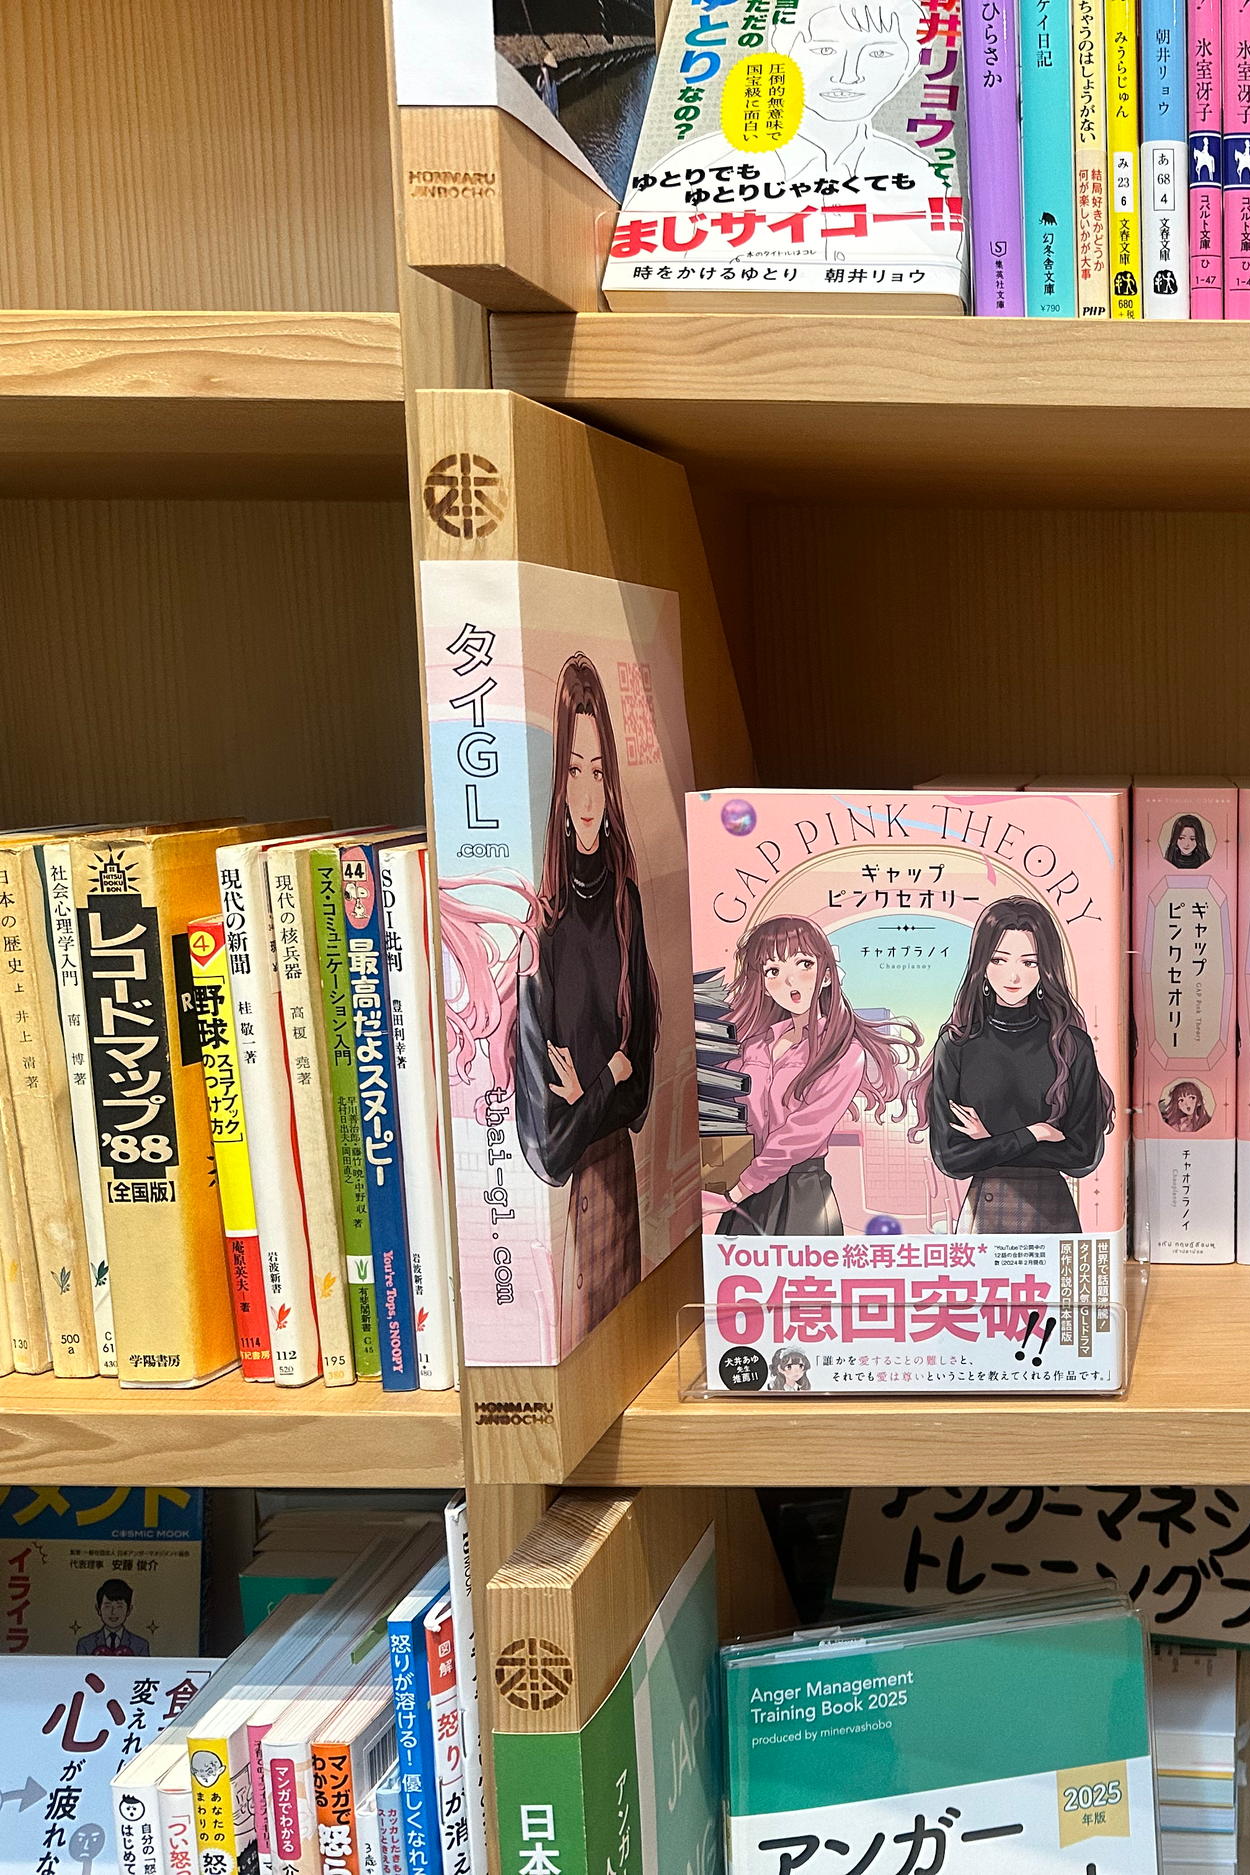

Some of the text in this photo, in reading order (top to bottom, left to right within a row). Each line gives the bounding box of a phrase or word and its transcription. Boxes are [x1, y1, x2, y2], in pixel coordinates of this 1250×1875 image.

[1114, 31, 1130, 118] みうらじゅん
[1155, 29, 1171, 116] 朝井リョウ
[1195, 37, 1213, 123] 氷室冴子
[743, 64, 763, 142] 国宝級に面白い
[766, 62, 786, 142] 圧倒的無意味で
[632, 163, 761, 191] ゆとりでも
[1158, 152, 1169, 166] あ
[684, 173, 916, 207] ゆとりじゃなくても
[1117, 177, 1130, 188] 23
[1157, 173, 1171, 185] 68
[1120, 195, 1127, 207] 6
[1160, 193, 1168, 205] 4
[609, 197, 965, 258] まじサイコー!!
[1078, 169, 1092, 280] 何が楽しいかが大事
[1091, 169, 1105, 272] 結局好きかどうか
[1159, 217, 1170, 262] 文春文庫
[1199, 194, 1211, 250] コバルト文庫
[1119, 218, 1131, 265] 文春文庫
[632, 265, 926, 284] 時をかけるゆとり 朝井リョウ
[1042, 232, 1056, 295] 幻冬舎文庫
[1195, 275, 1217, 285] 1-47
[994, 260, 1005, 310] 集英社文庫
[1118, 299, 1133, 309] 680
[1082, 306, 1106, 316] PHP
[446, 622, 510, 858] タイGL .com
[344, 863, 364, 880] 44
[712, 803, 1102, 926] GAP PINK THEORY
[861, 862, 946, 884] ギャップ
[828, 889, 980, 909] ピンクセオリー
[50, 865, 79, 987] 社会心理学入門
[220, 868, 251, 975] 現代の新聞
[275, 874, 303, 980] 現代の核兵器
[381, 869, 403, 973] SDI批判
[1191, 901, 1209, 977] ギャップ
[317, 866, 352, 1067] マス・コミュニケーション入門
[860, 945, 950, 959] チャオプラノイ
[879, 962, 932, 971] Chaoplanoy
[1167, 901, 1186, 1048] ピンクセオリー
[87, 911, 174, 1164] レコードマップ '88
[347, 938, 395, 1186] 最高だよスヌーピー
[484, 1086, 515, 1306] thai-gl.com
[268, 1251, 282, 1294] 岩波新書
[412, 1253, 424, 1296] 岩波新書
[382, 1250, 405, 1374] You're Tops, SNOOPY
[1060, 1242, 1073, 1343] 原作小説の日本語版
[1078, 1243, 1091, 1355] タイの大人気GLドラマ
[13, 1338, 28, 1350] 130
[60, 1334, 80, 1345] 500
[68, 1346, 75, 1355] a
[104, 1331, 113, 1341] C
[240, 1337, 261, 1347] 1114
[276, 1350, 297, 1361] 112
[128, 1353, 181, 1368] 学陽書房
[323, 1356, 346, 1367] 195
[724, 1355, 760, 1368] 犬井あゆ
[736, 1366, 751, 1374] 先生
[814, 1354, 974, 1368] 「誰かを愛することの難しさと、
[474, 1402, 554, 1414] HONMARU
[475, 1414, 555, 1426] JINBOCHO
[111, 1529, 190, 1539] COSMIC MOOK
[70, 1559, 104, 1570] 代表理事
[6, 1547, 32, 1654] イライラ
[438, 1640, 454, 1678] 図解
[750, 1669, 914, 1708] Anger Management
[750, 1688, 908, 1726] Training Book 2025
[751, 1717, 893, 1749] produced by minervashobo
[311, 1754, 329, 1808] わかる
[328, 1754, 352, 1826] マンガで
[1063, 1779, 1122, 1814] 2025
[197, 1792, 209, 1842] まわりの
[211, 1792, 226, 1842] あなたの
[275, 1767, 295, 1854] マンガでわかる
[1081, 1811, 1107, 1827] 年版
